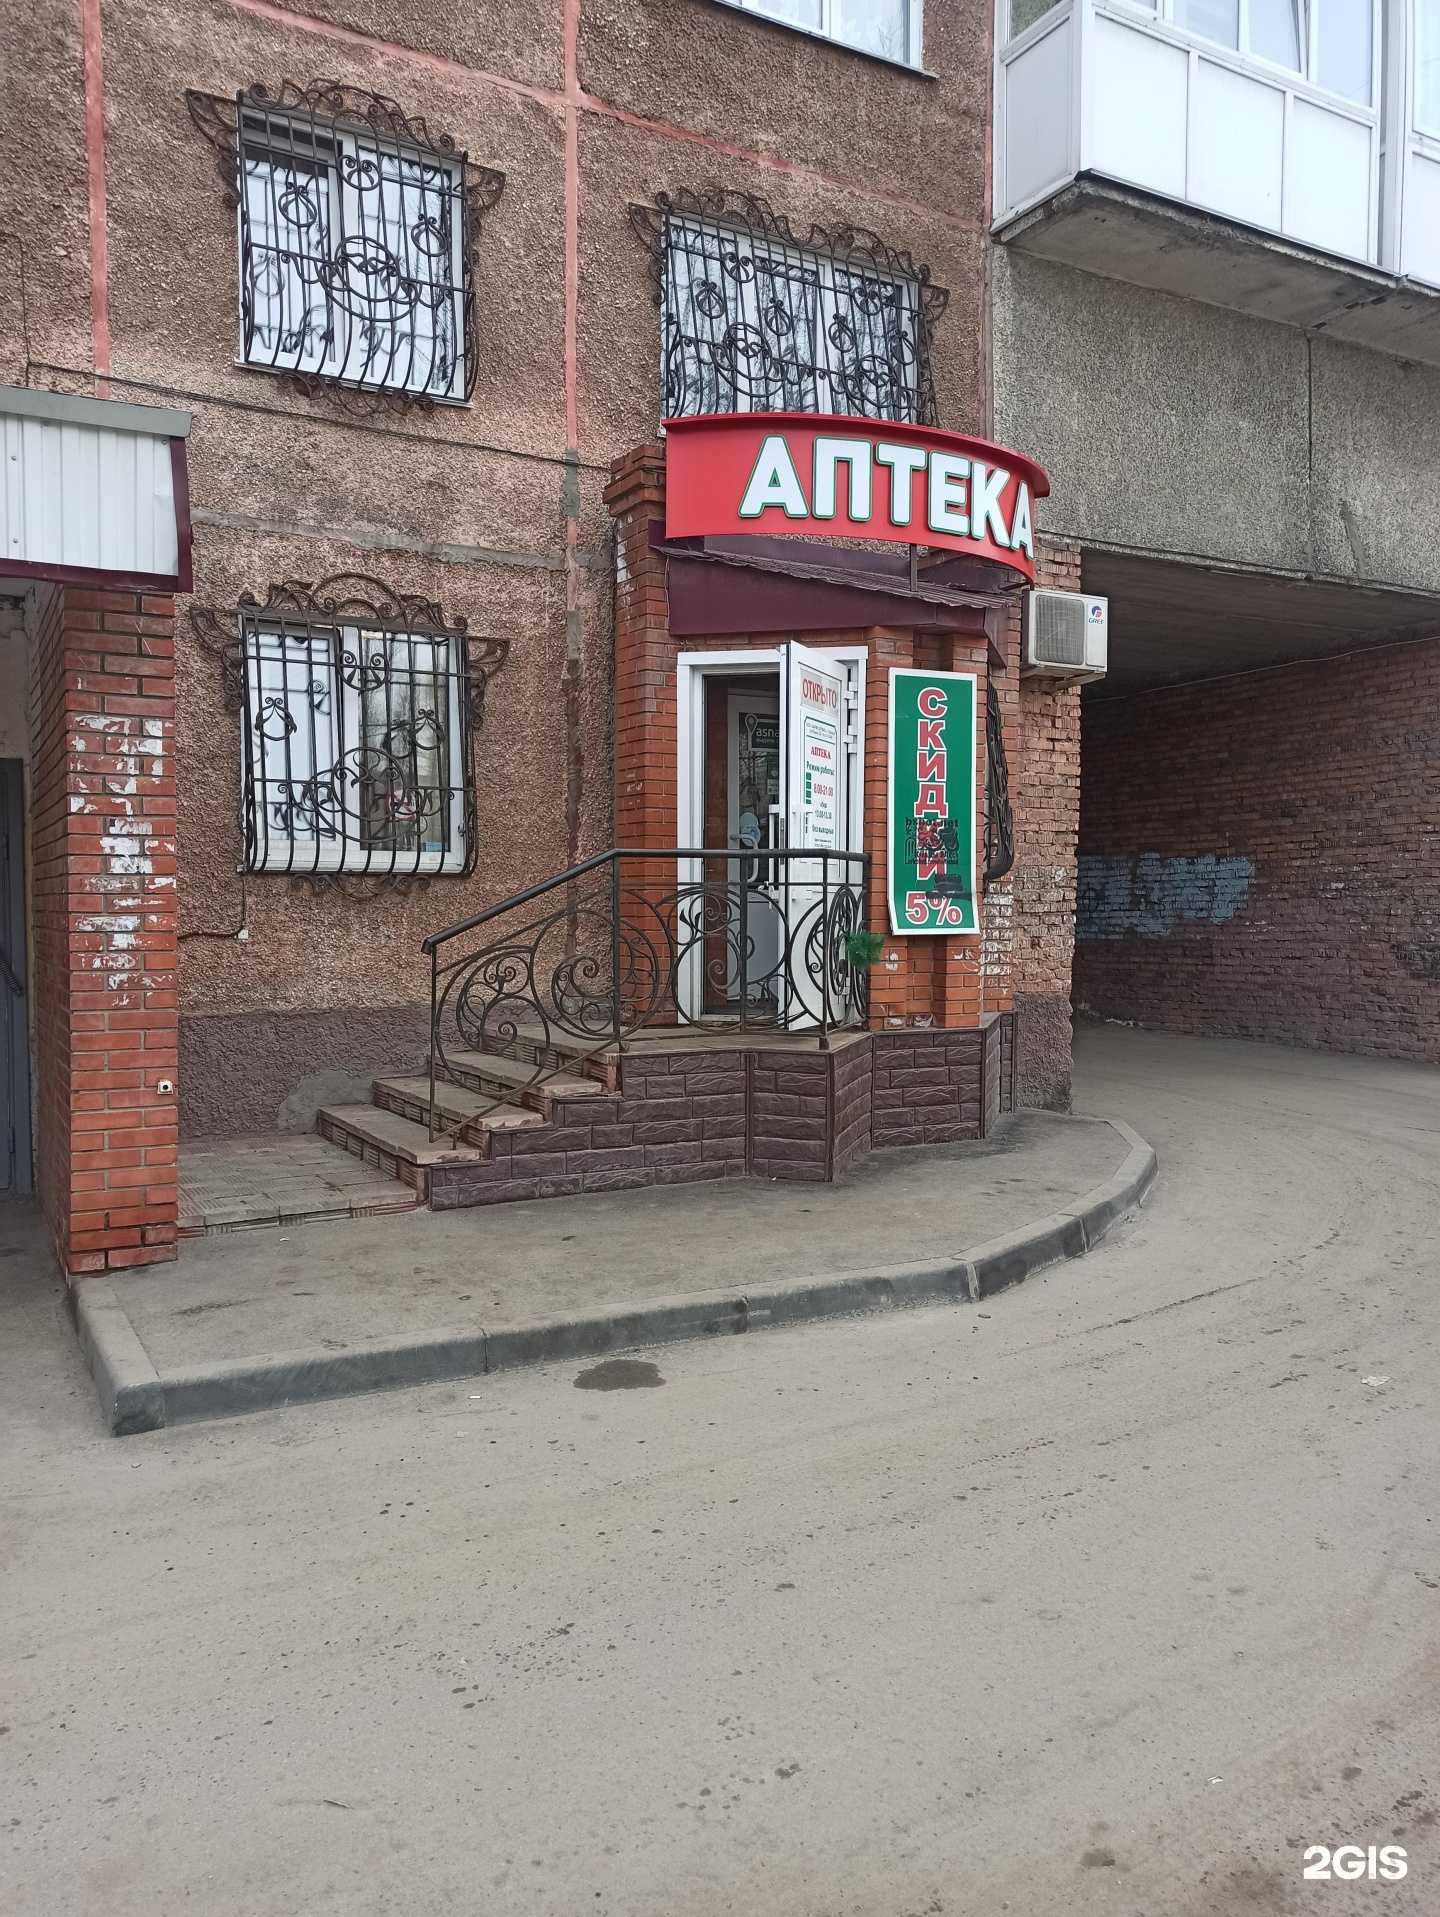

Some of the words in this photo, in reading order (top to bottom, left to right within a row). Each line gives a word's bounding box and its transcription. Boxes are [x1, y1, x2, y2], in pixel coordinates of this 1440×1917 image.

[738, 434, 1034, 560] АПТЕКА
[802, 678, 837, 709] ОТКРЫТО
[810, 746, 831, 760] АПТЕКА
[914, 686, 949, 880] СКИДКИ
[905, 891, 963, 926] 5%
